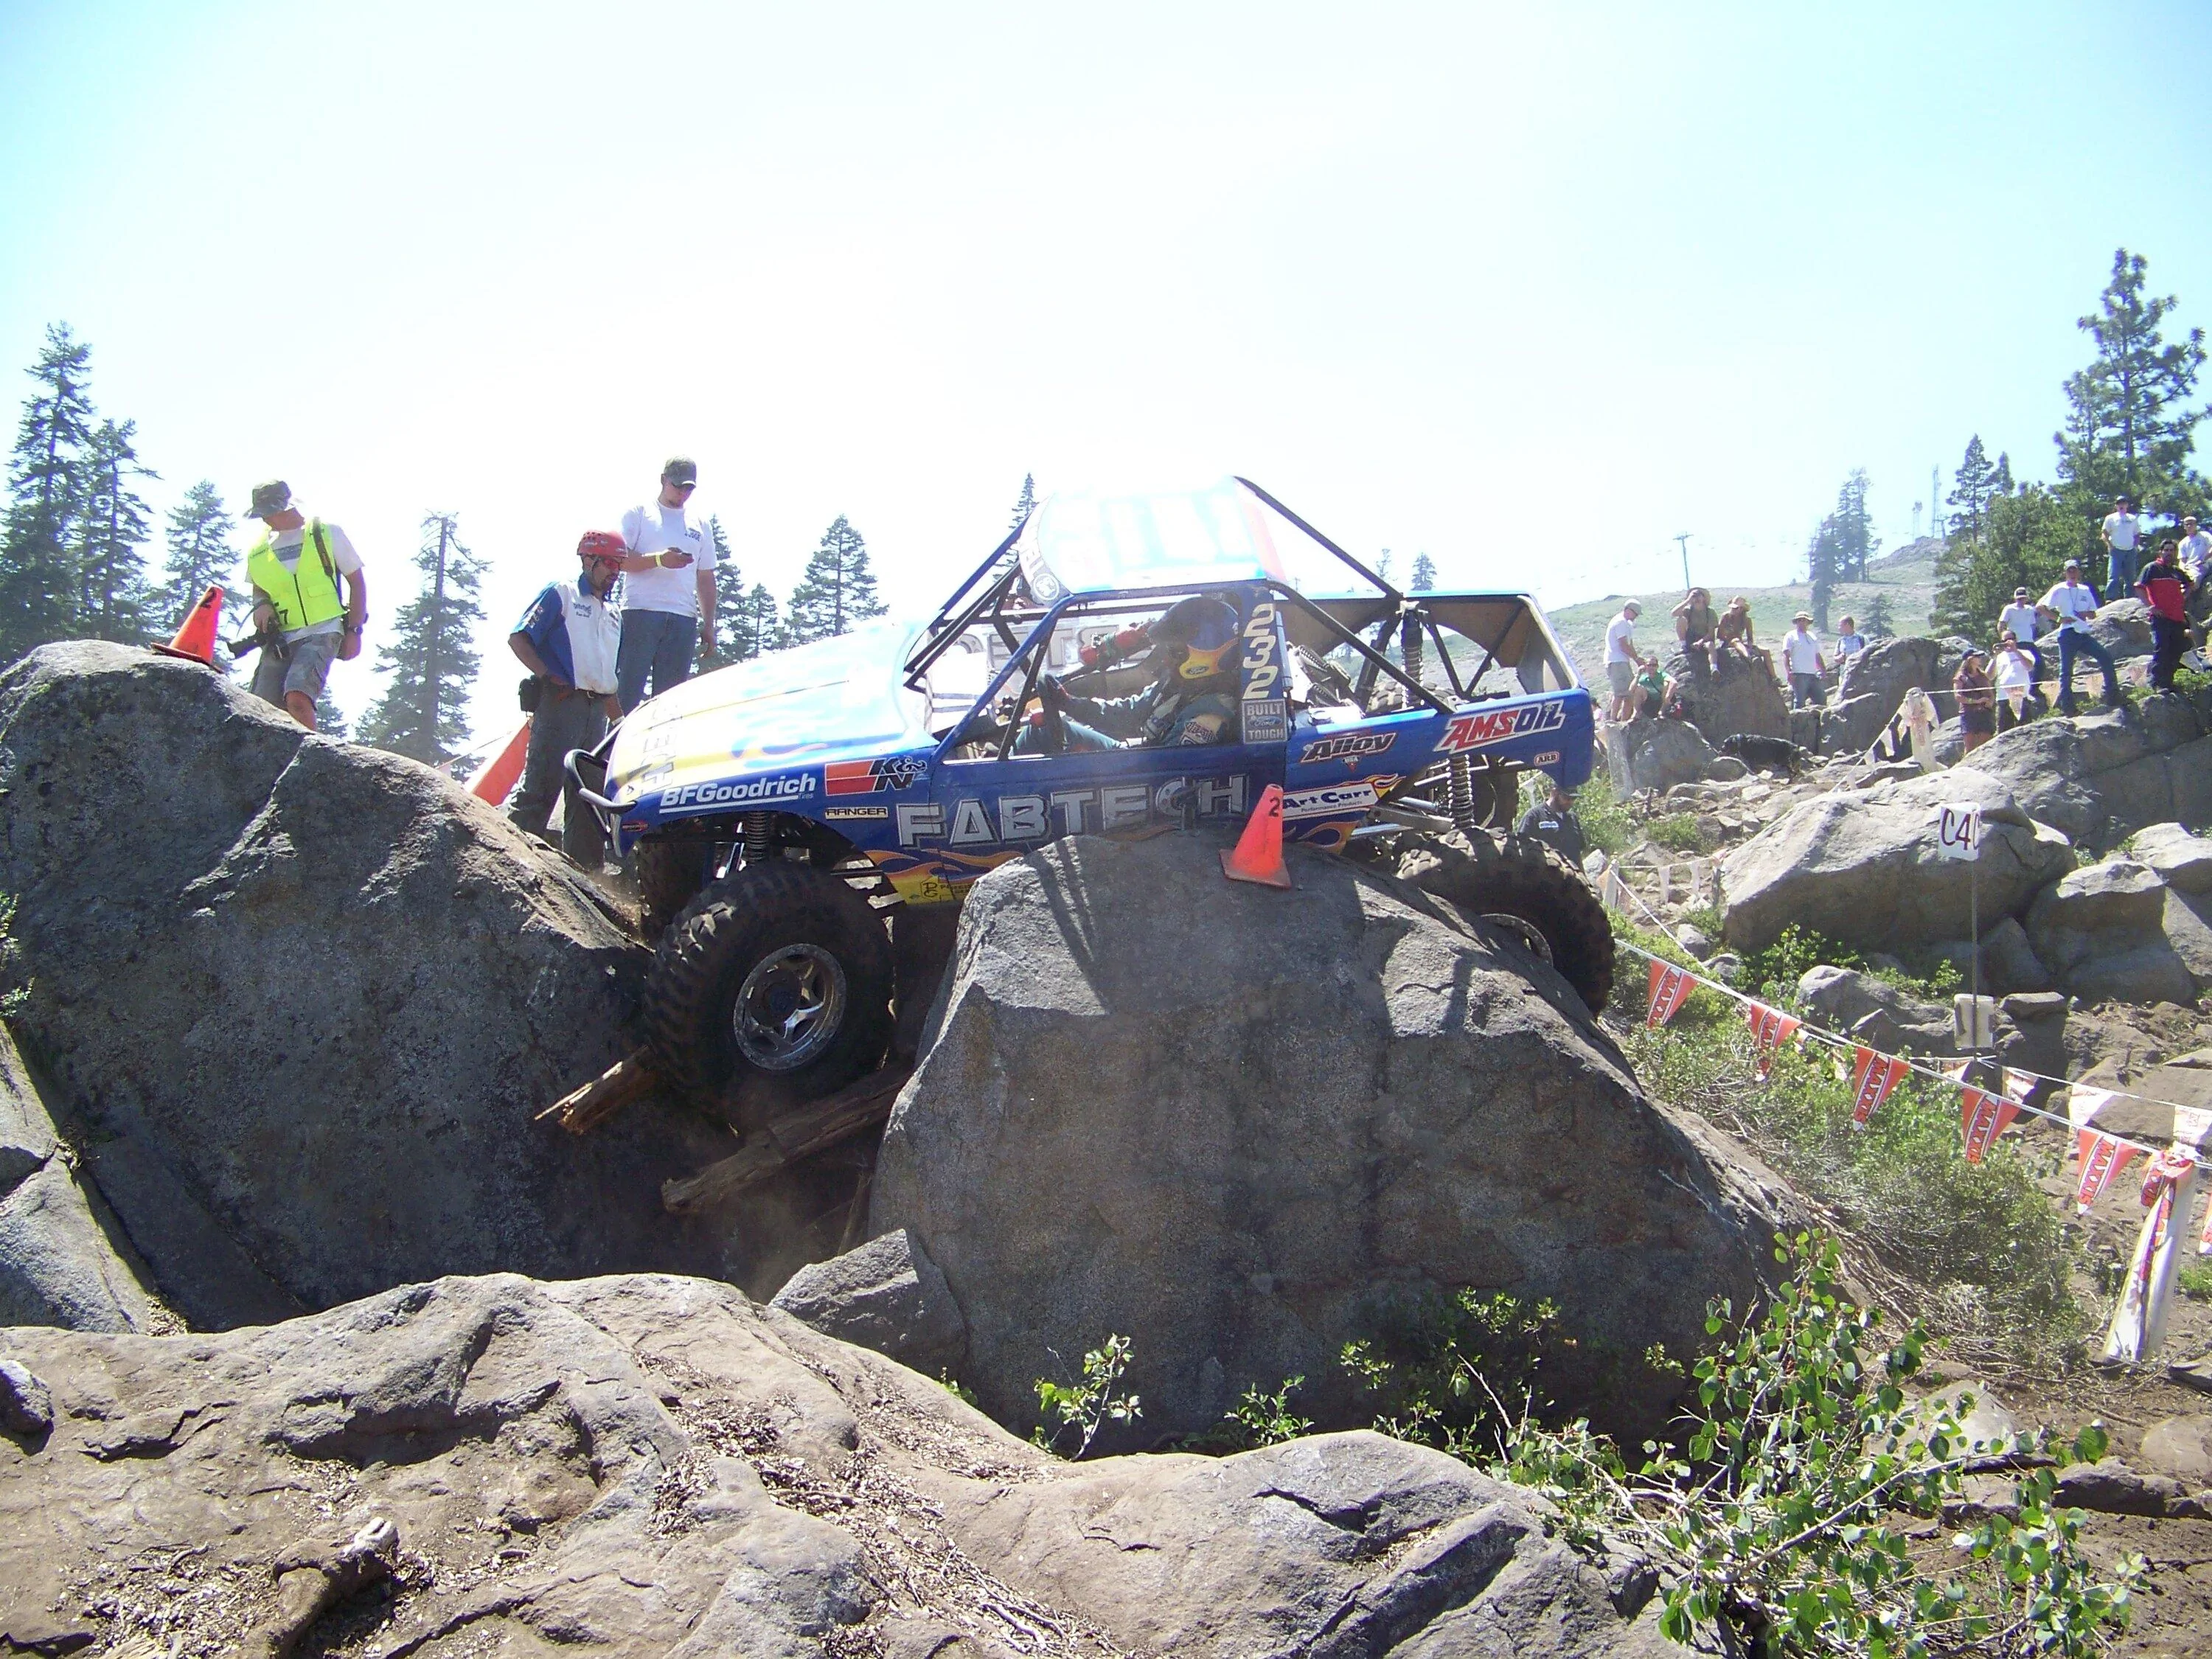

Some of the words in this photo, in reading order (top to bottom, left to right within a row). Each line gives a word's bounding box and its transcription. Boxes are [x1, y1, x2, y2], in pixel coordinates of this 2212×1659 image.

[1243, 603, 1279, 699] 232
[1247, 703, 1282, 716] BUILT
[1438, 701, 1564, 752] AMSOIL
[1248, 728, 1284, 740] TOUGH
[1301, 733, 1396, 762] Alloy
[869, 756, 928, 791] K&N
[1537, 754, 1557, 764] ARB
[660, 773, 816, 807] BFGoodrich
[1268, 796, 1281, 817] 2
[827, 807, 888, 816] RANGER
[896, 775, 1250, 849] FABTECH
[1647, 970, 1680, 1026] MAXX
[1854, 1055, 1889, 1123] MAXXIS
[2078, 1139, 2115, 1206] MAXXIS
